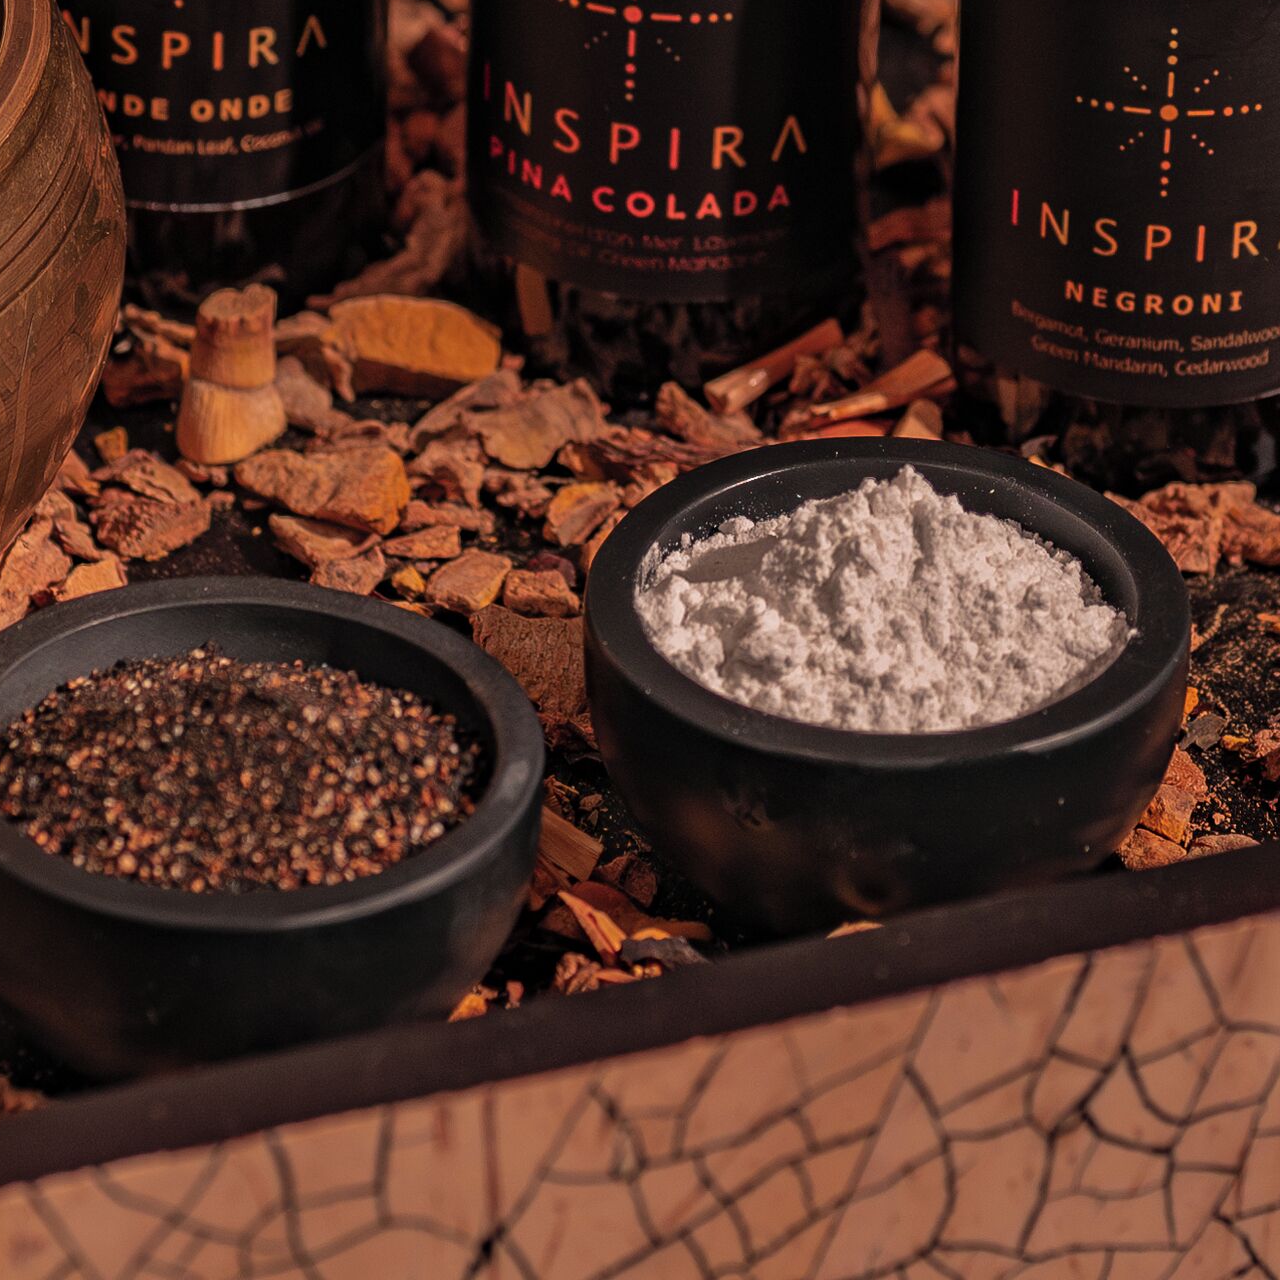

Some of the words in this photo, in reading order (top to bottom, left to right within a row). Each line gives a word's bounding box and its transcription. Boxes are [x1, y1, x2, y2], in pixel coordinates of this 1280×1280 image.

[61, 8, 327, 72] NSPIRA
[97, 87, 170, 121] NDE
[190, 87, 294, 123] ONDE
[483, 60, 806, 171] INSPIRA
[489, 134, 573, 204] PINA
[591, 184, 791, 221] COLADA
[1064, 280, 1244, 315] NEGRONI
[1030, 334, 1079, 363] Green
[1174, 347, 1270, 376] Cedarwood
[1094, 328, 1185, 353] Geranium,
